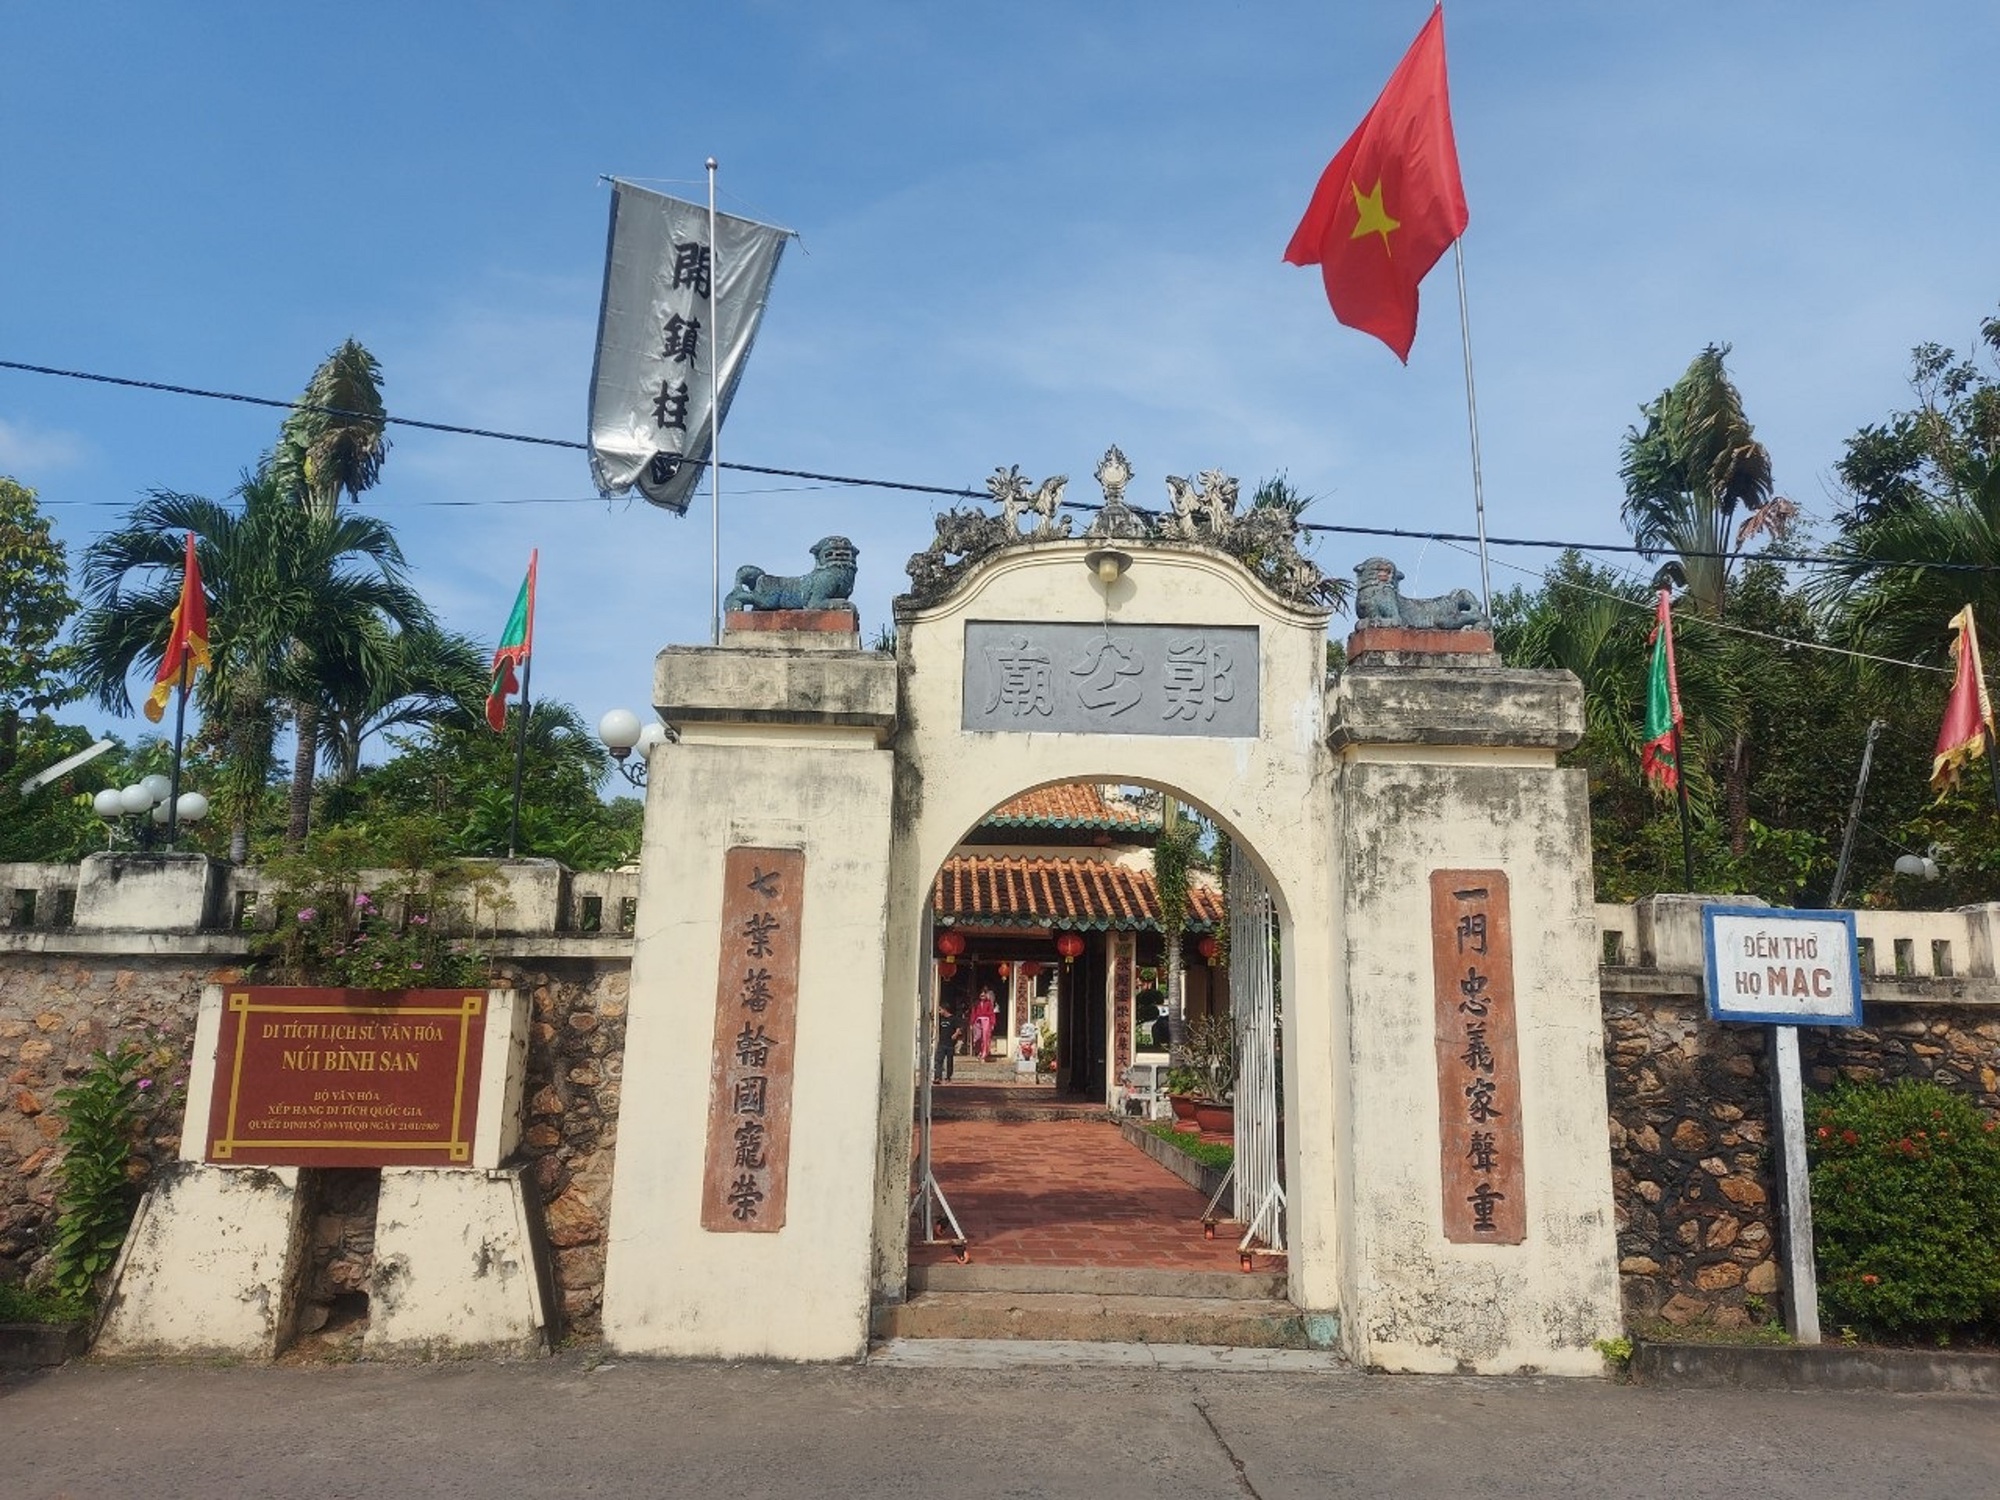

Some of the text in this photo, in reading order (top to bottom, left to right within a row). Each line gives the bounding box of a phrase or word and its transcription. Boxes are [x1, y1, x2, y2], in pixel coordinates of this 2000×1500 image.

[1735, 966, 1832, 1002] HỌ MẠC
[262, 1024, 279, 1039] DI
[283, 1020, 318, 1039] TÍCH
[321, 1024, 356, 1043] LỊCH
[381, 1022, 411, 1041] VĂN
[414, 1021, 443, 1041] HÓA
[282, 1044, 419, 1072] NÚI BÌNH SAN
[1453, 886, 1505, 1232] 一門忠義家聲重
[332, 1089, 356, 1101] VĂN
[357, 1090, 380, 1101] HÓA
[268, 1101, 423, 1118] XẾP HẠNG DI TÍCH QUỐC GIA
[247, 1116, 281, 1130] QUYẾT
[308, 1118, 321, 1129] SỐ
[370, 1119, 398, 1131] NGÀY
